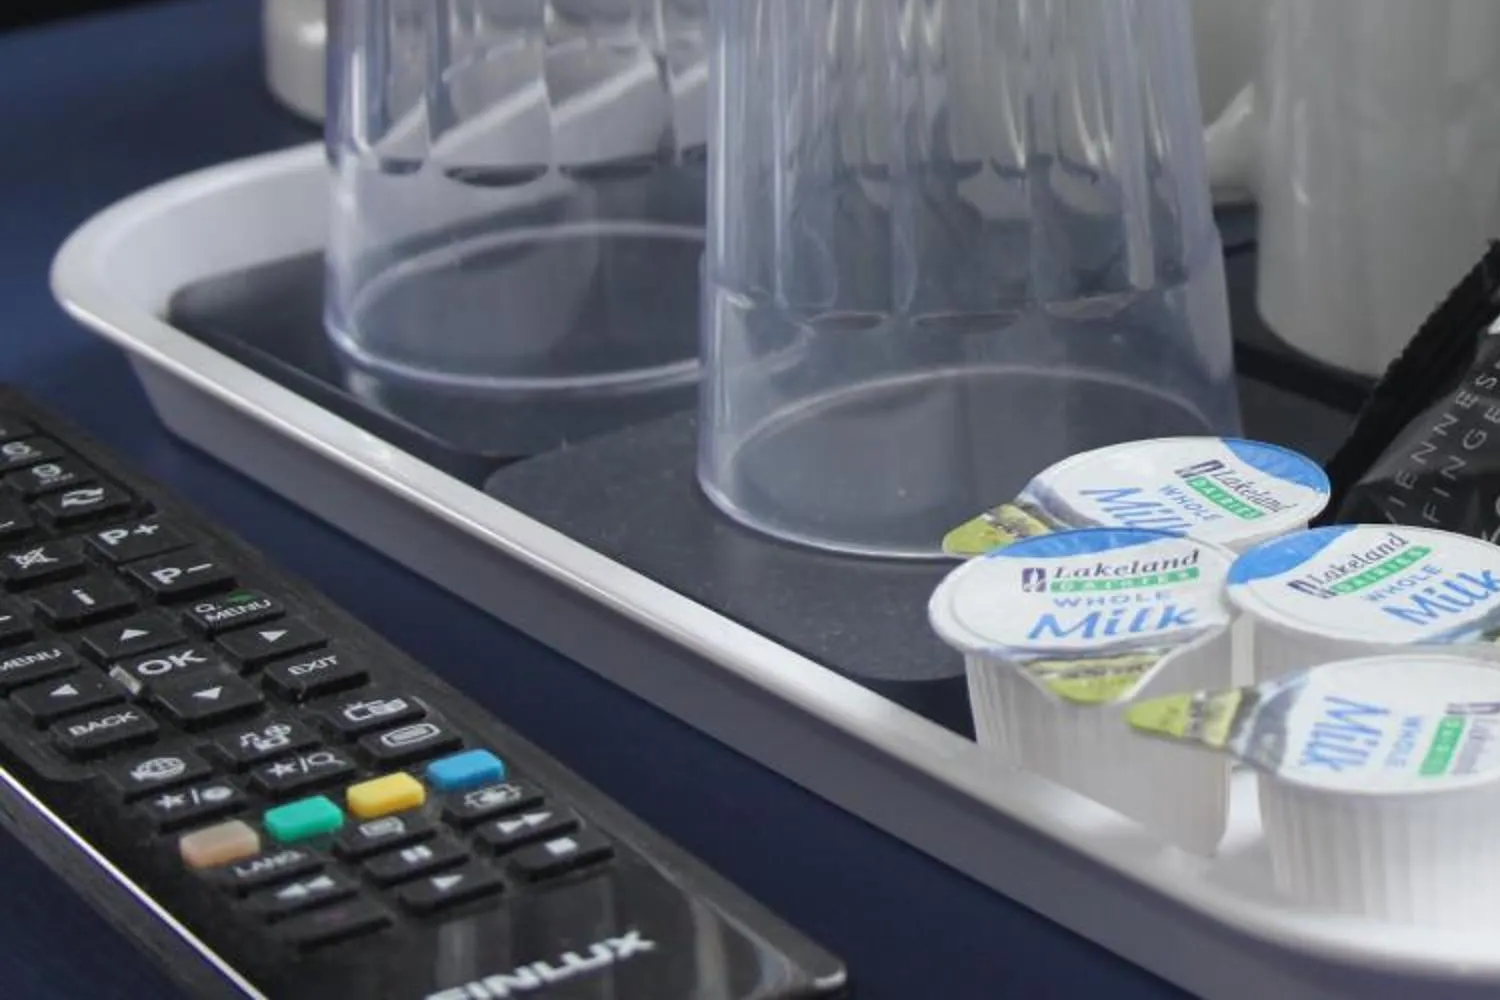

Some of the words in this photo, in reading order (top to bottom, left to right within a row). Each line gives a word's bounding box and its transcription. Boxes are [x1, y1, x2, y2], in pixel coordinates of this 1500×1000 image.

[1053, 549, 1201, 580] Lakeland
[1306, 531, 1410, 585] Lakeland
[1363, 564, 1443, 602] WHOLE
[204, 599, 273, 622] MENU
[1052, 591, 1174, 608] WHOLE
[1027, 604, 1198, 640] Milk
[136, 649, 208, 676] OK
[287, 654, 340, 677] EXIT
[67, 711, 140, 737] BACK
[1300, 695, 1393, 772] Milk
